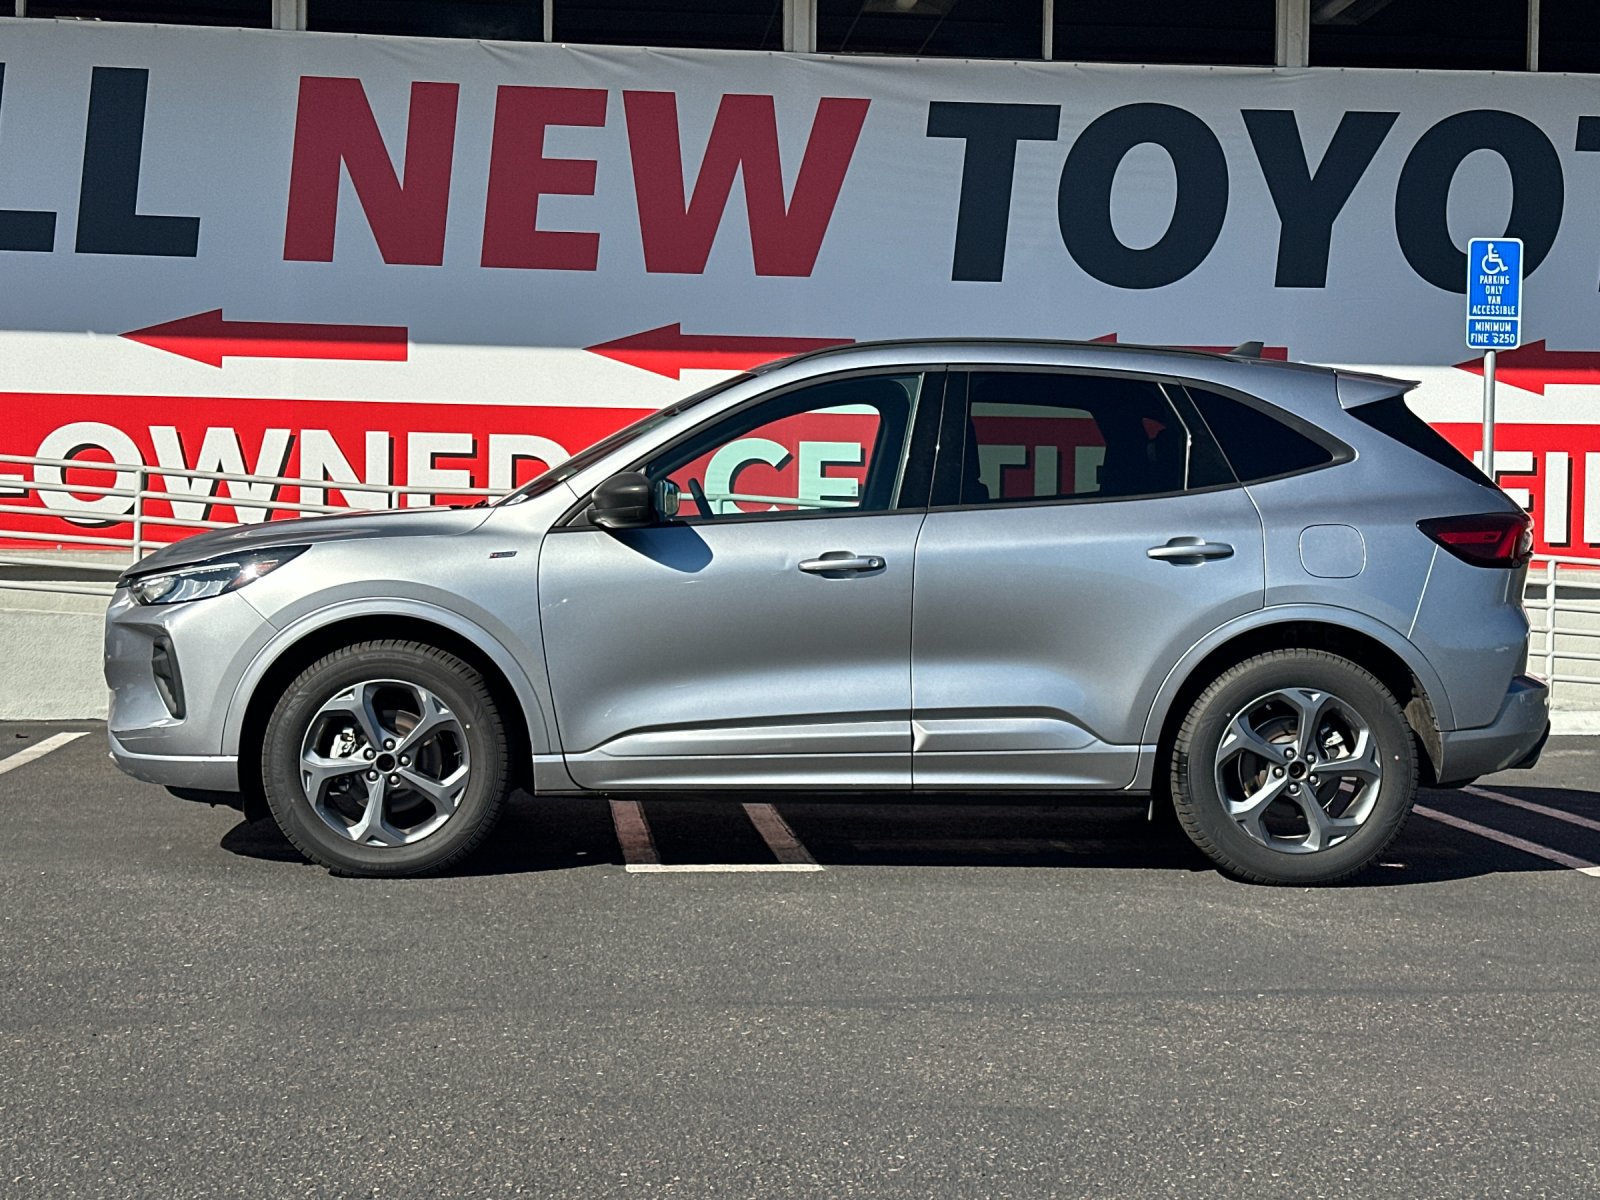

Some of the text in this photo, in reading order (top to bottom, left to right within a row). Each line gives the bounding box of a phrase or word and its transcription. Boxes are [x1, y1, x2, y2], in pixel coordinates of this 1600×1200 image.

[283, 76, 871, 277] NEW
[926, 101, 1600, 294] TOYO
[1479, 275, 1510, 284] PARKING
[1485, 285, 1503, 294] ONLY
[1487, 295, 1501, 304] VAN
[1472, 305, 1515, 315] ACCESSIBLE
[1475, 321, 1511, 331] MINIMUM
[1470, 333, 1489, 343] FINE
